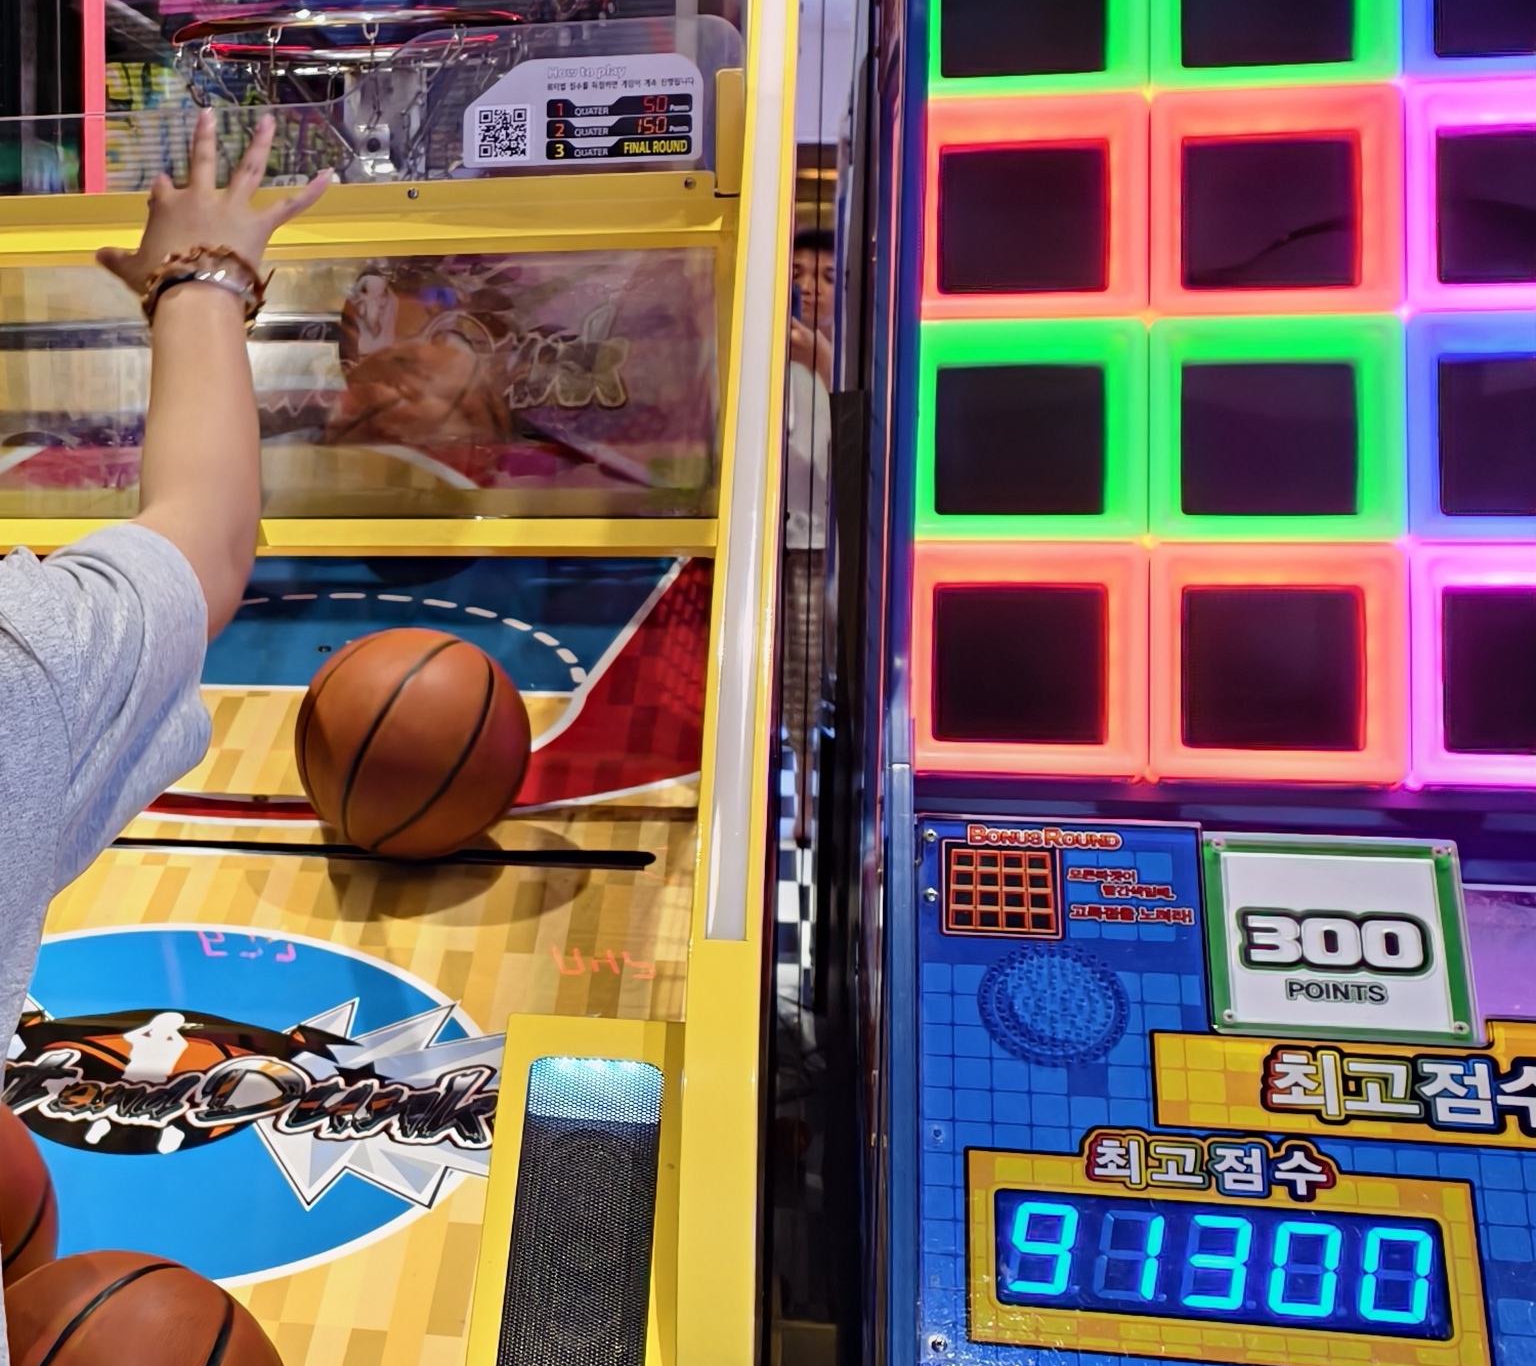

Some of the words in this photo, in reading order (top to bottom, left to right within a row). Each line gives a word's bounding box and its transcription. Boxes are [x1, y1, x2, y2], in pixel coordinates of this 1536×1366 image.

[547, 66, 577, 79] How
[580, 66, 595, 78] to
[597, 64, 627, 80] play
[574, 106, 609, 117] QUATER
[643, 95, 668, 113] 50
[555, 123, 565, 137] 2
[574, 126, 609, 137] QUATER
[637, 115, 668, 135] 150
[555, 143, 565, 158] 3
[574, 147, 609, 158] QUATER
[623, 140, 651, 155] FINAL
[653, 139, 688, 154] ROUND
[968, 825, 1043, 847] BONUS
[1044, 827, 1123, 849] ROUND
[1243, 914, 1429, 971] 300
[1286, 979, 1389, 1005] POINTS
[1091, 1139, 1330, 1198] 최고점수
[1007, 1201, 1435, 1326] 91300
